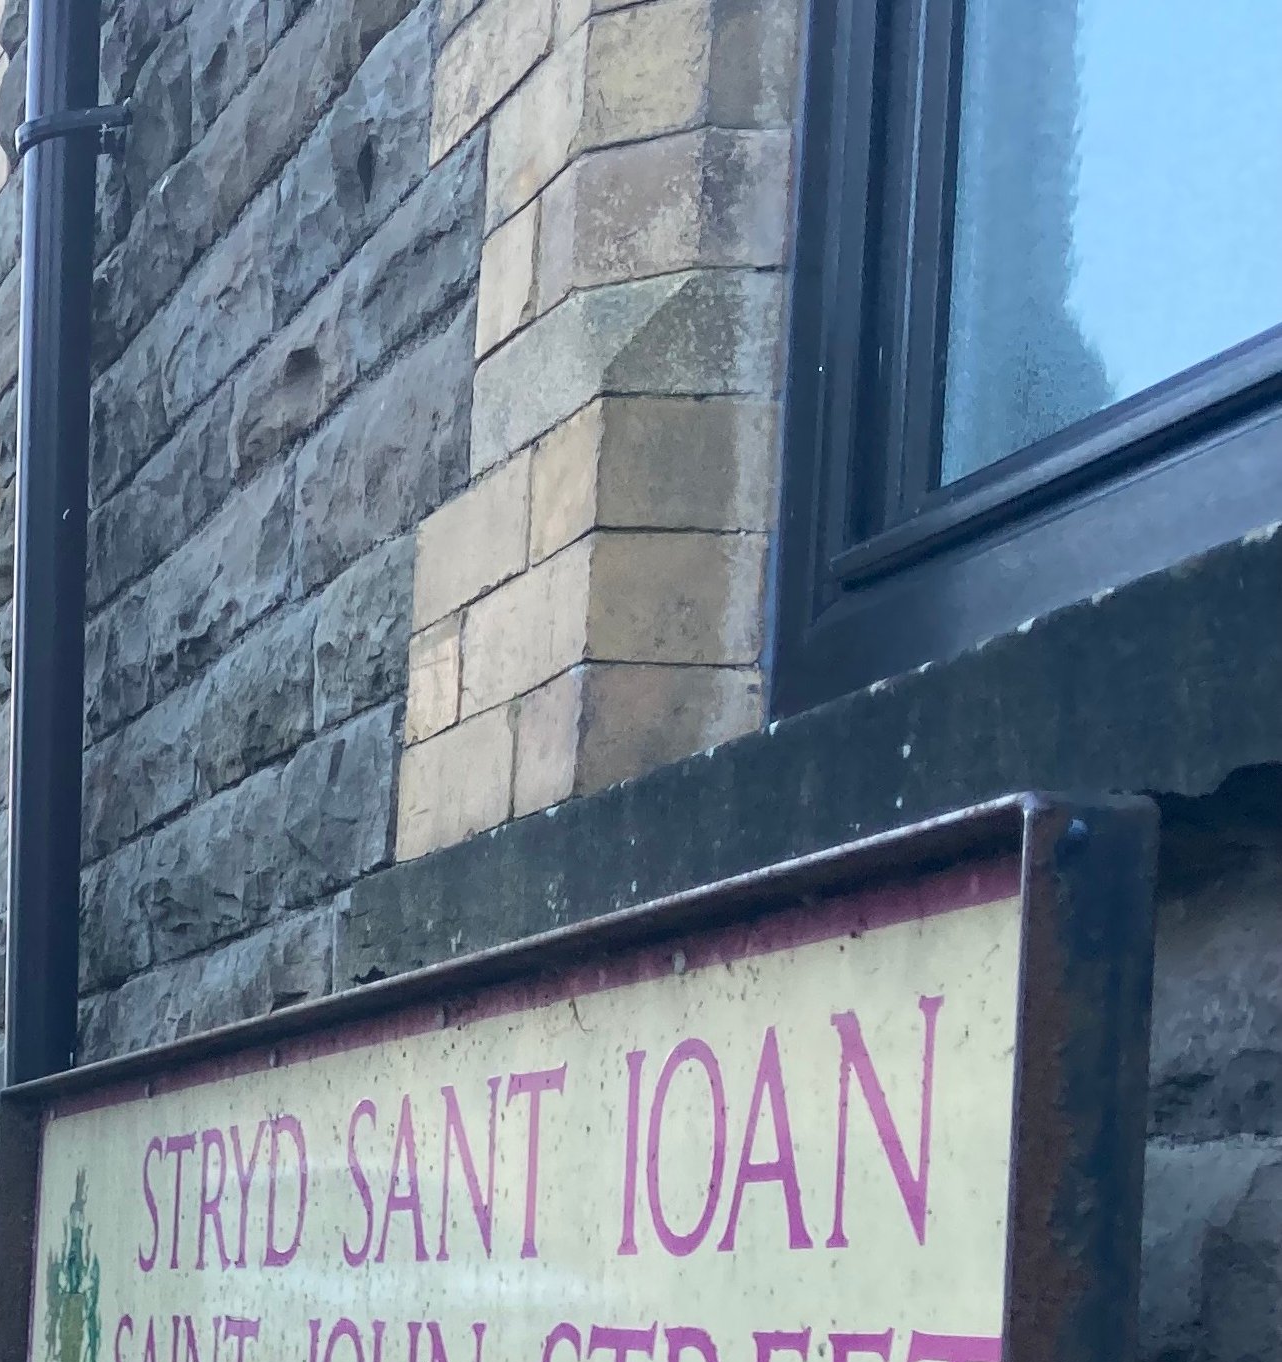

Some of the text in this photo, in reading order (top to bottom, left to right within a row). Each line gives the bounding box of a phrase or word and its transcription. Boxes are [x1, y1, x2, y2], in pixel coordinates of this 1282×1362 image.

[137, 994, 945, 1274] STRYD SANT IOAN
